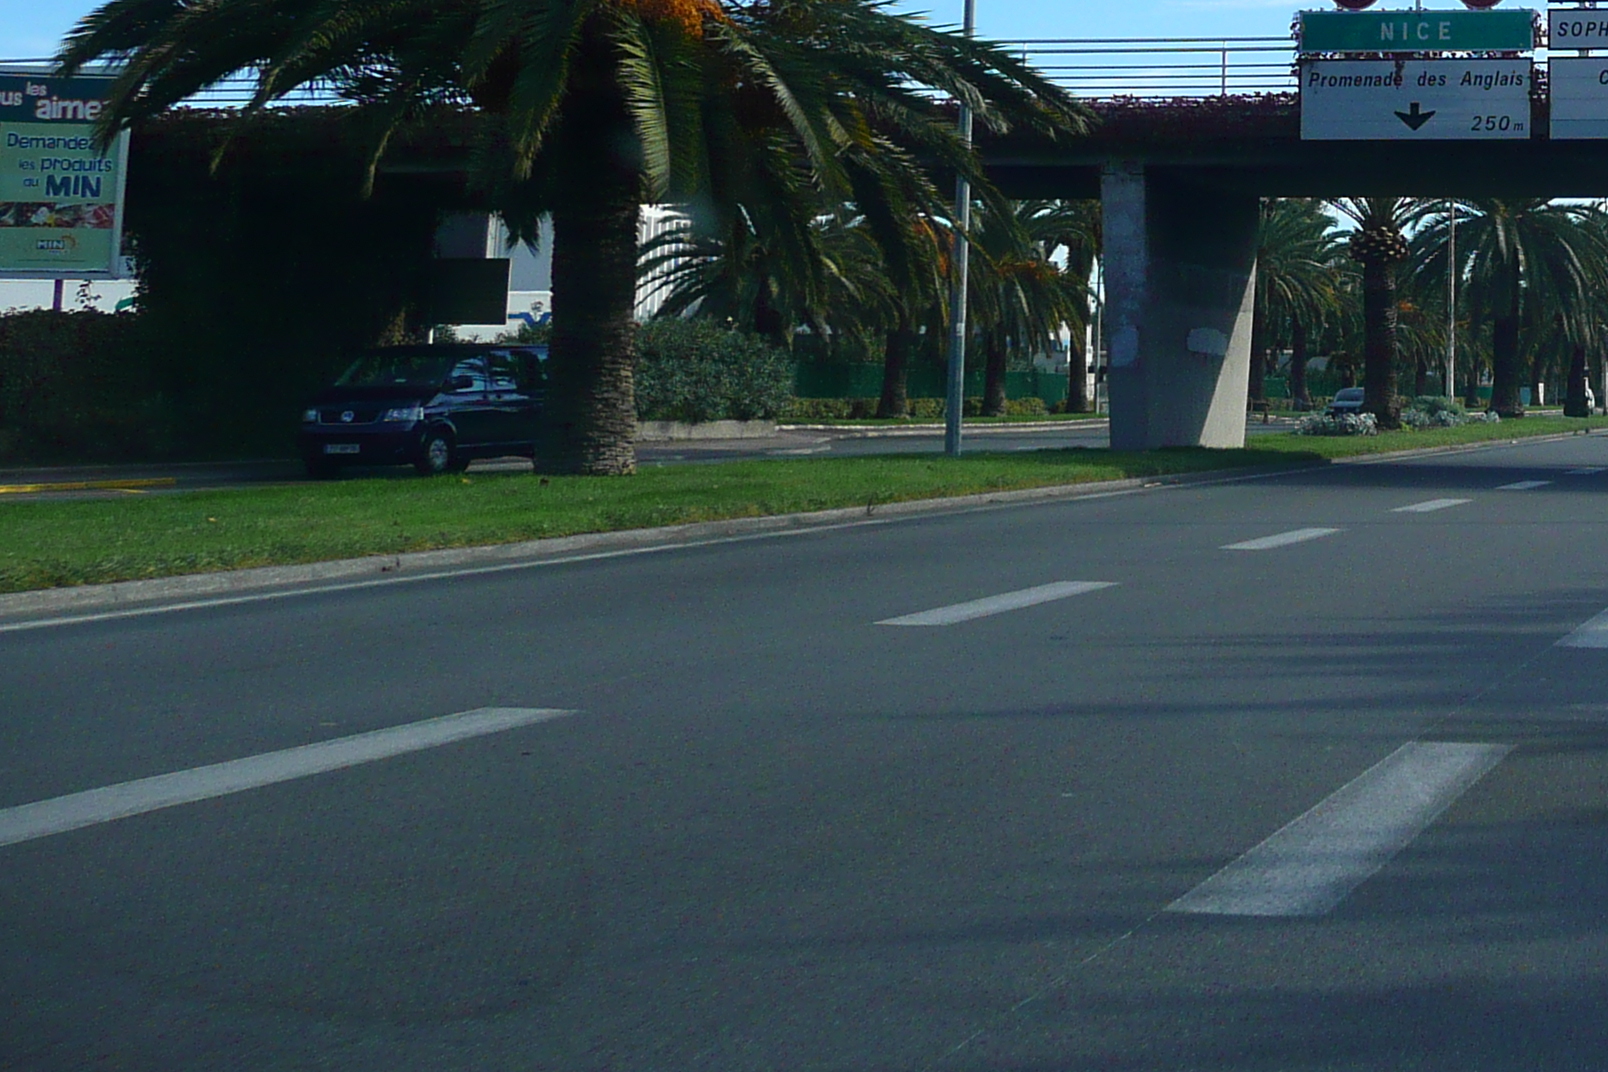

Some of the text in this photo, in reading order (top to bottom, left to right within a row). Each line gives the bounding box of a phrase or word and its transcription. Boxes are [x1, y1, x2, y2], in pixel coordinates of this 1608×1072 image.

[1380, 21, 1451, 41] NICE
[1308, 70, 1523, 90] Promenade des Anglais
[0, 81, 112, 120] us les aime
[1471, 115, 1510, 131] 250
[19, 157, 112, 172] les produits
[23, 174, 101, 198] du MIN
